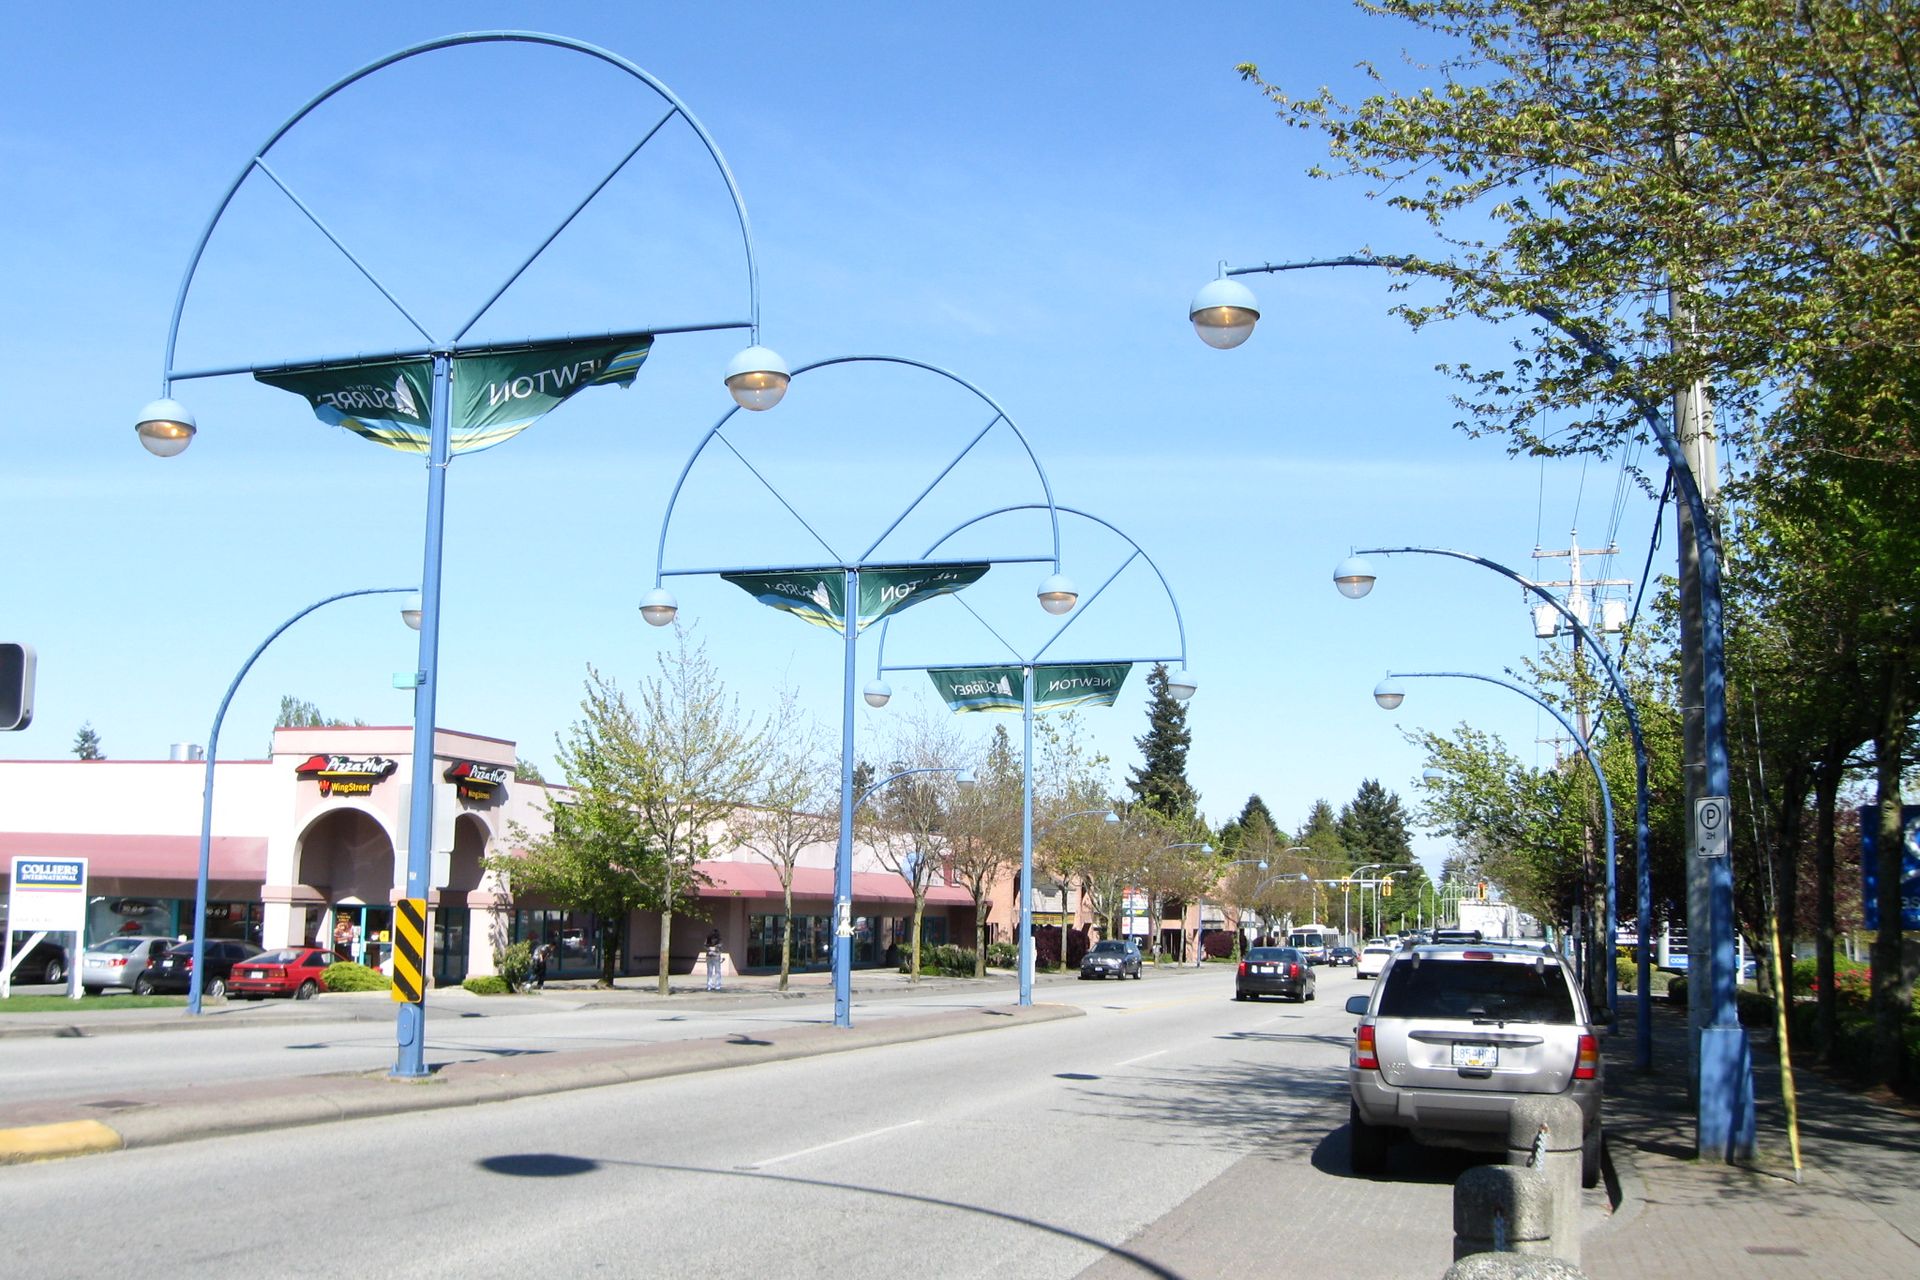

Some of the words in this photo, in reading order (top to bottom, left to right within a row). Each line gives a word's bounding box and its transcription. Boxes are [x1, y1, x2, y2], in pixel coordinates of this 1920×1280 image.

[325, 756, 362, 772] Pizza
[361, 758, 392, 773] Hut
[469, 764, 490, 781] Pizza
[489, 768, 507, 784] Hut
[331, 782, 370, 793] WingStreet
[1706, 809, 1716, 825] P
[21, 864, 79, 875] COLLIERS
[21, 873, 78, 882] INTERNATIONAL
